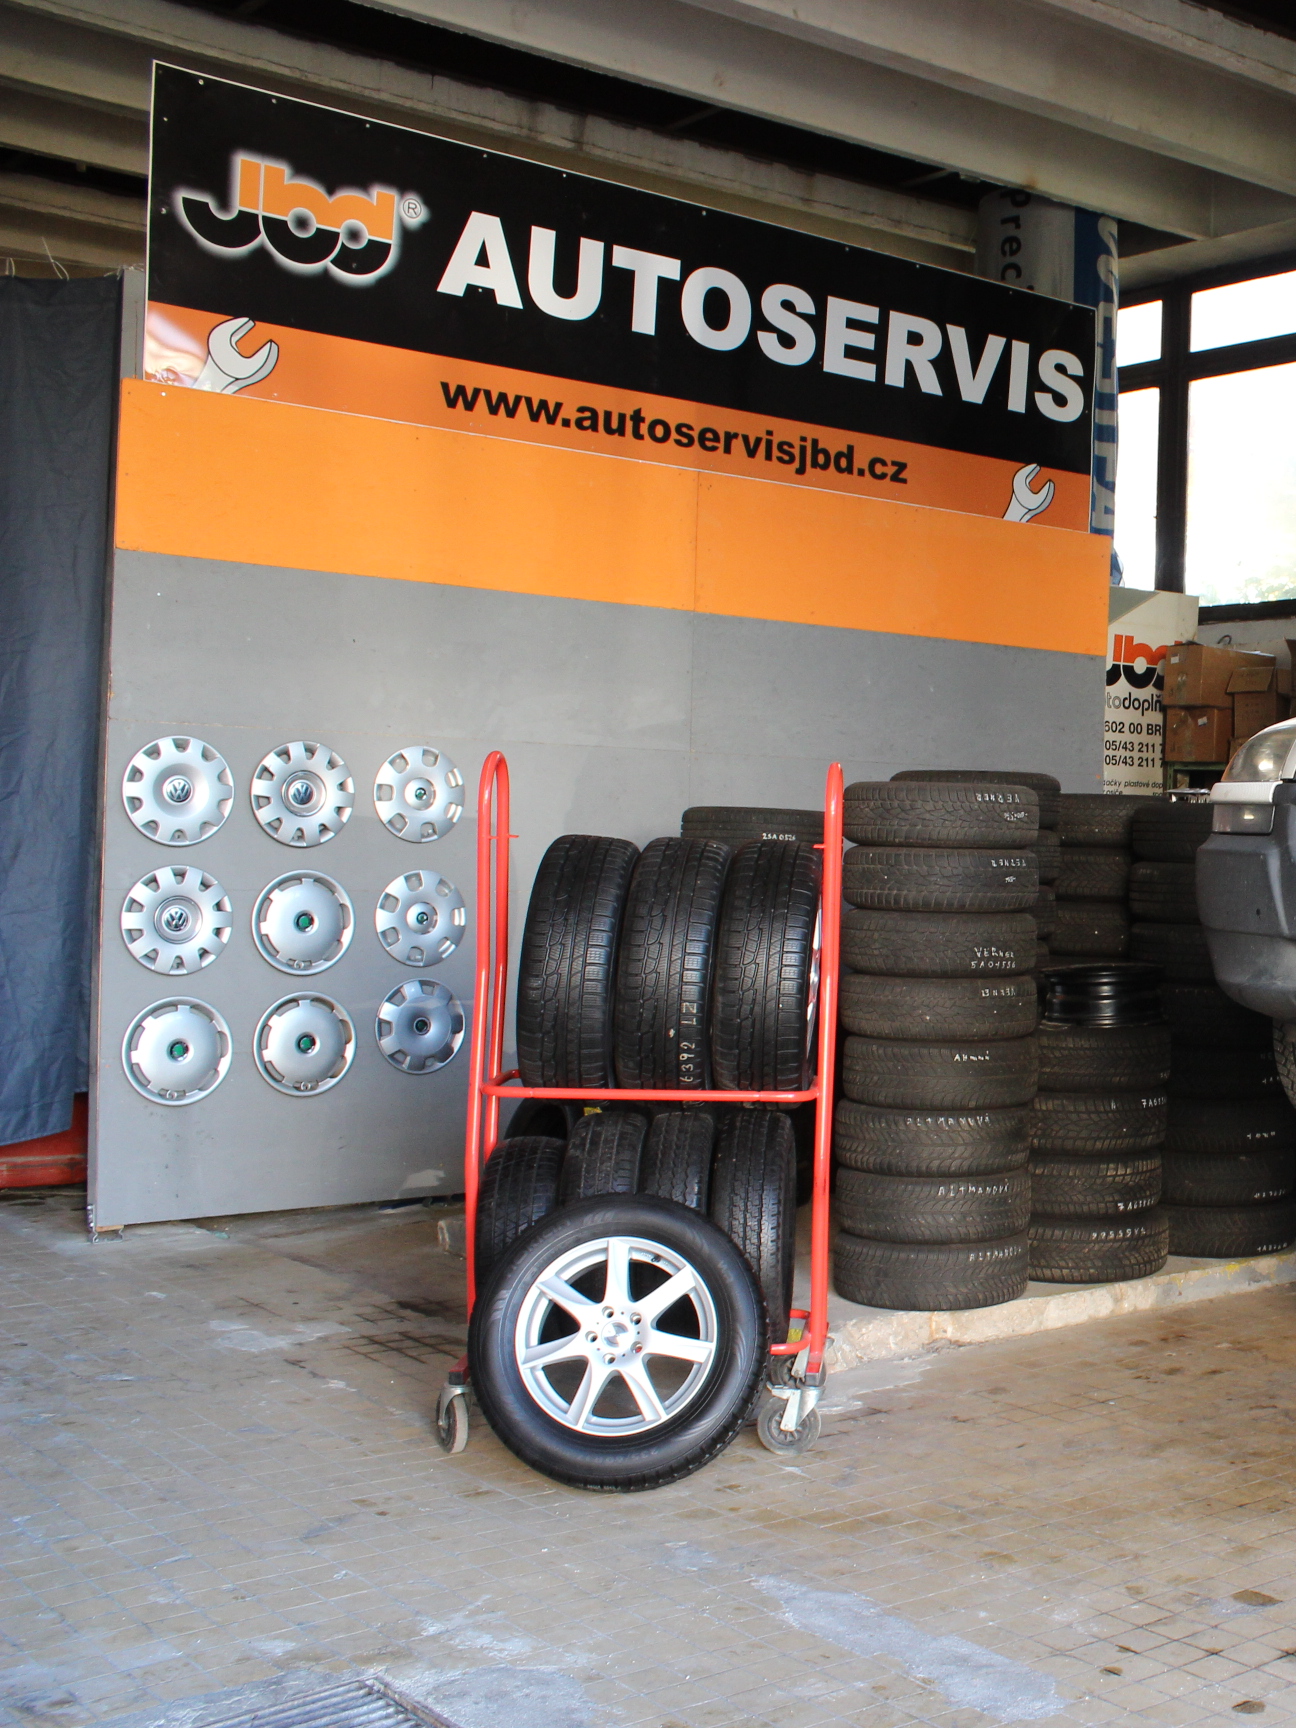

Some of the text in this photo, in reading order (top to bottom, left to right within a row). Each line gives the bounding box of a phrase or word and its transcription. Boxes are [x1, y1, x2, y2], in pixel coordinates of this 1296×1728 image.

[1000, 188, 1034, 291] Prec
[437, 211, 1085, 422] AUTOSERVIS
[439, 381, 909, 485] www.autoservisjbd.cz
[1104, 740, 1135, 752] 05/43
[1137, 742, 1156, 754] 211
[1128, 722, 1143, 735] 00
[1104, 754, 1135, 767] 05/43
[1137, 756, 1156, 768] 211
